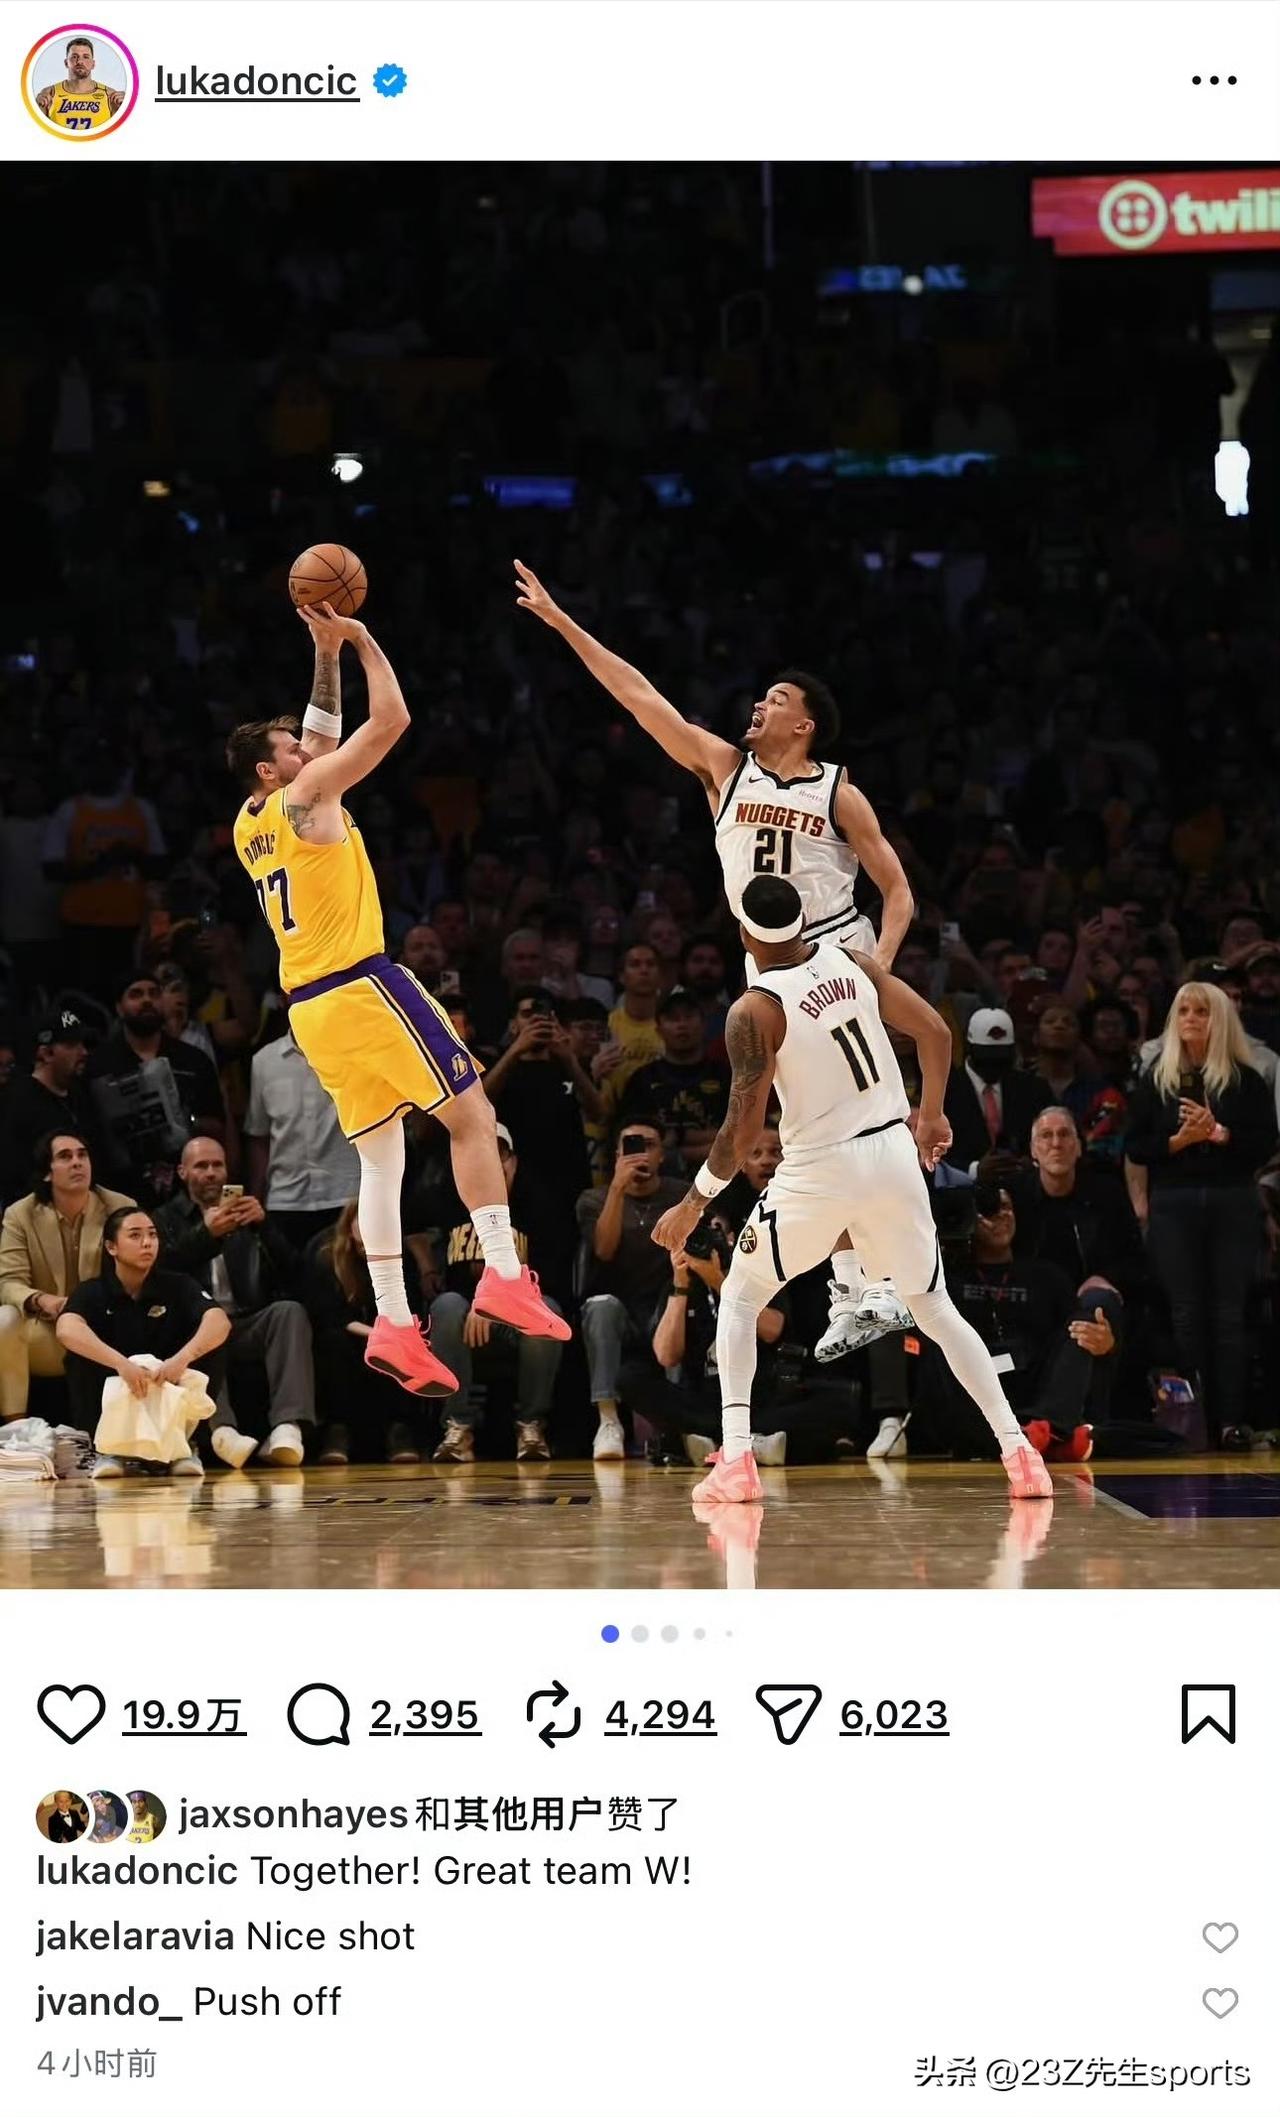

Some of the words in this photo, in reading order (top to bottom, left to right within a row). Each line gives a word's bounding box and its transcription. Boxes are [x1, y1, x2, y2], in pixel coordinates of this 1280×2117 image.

[57, 99, 101, 114] LAKERS
[735, 802, 827, 838] NUGGETS
[753, 828, 793, 874] 21
[799, 977, 857, 1020] BROWN
[830, 1017, 880, 1092] 11
